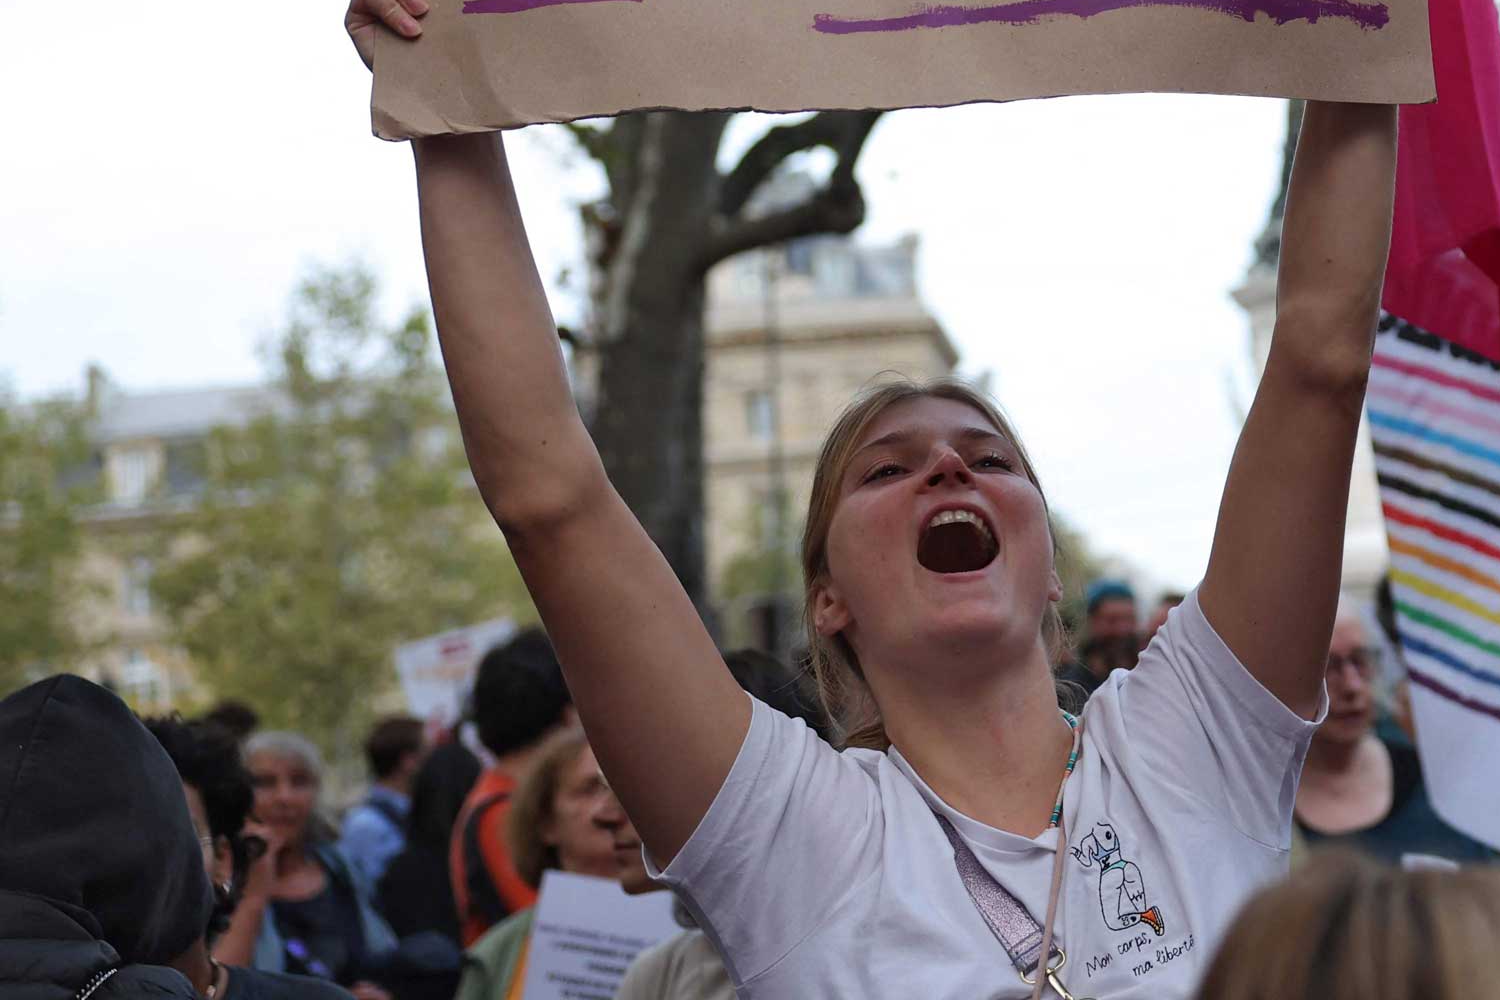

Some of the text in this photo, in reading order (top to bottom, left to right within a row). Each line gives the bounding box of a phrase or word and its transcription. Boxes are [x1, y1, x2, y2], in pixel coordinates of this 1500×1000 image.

[1086, 932, 1151, 977] Mon corps,
[1132, 934, 1195, 976] ma liberté
